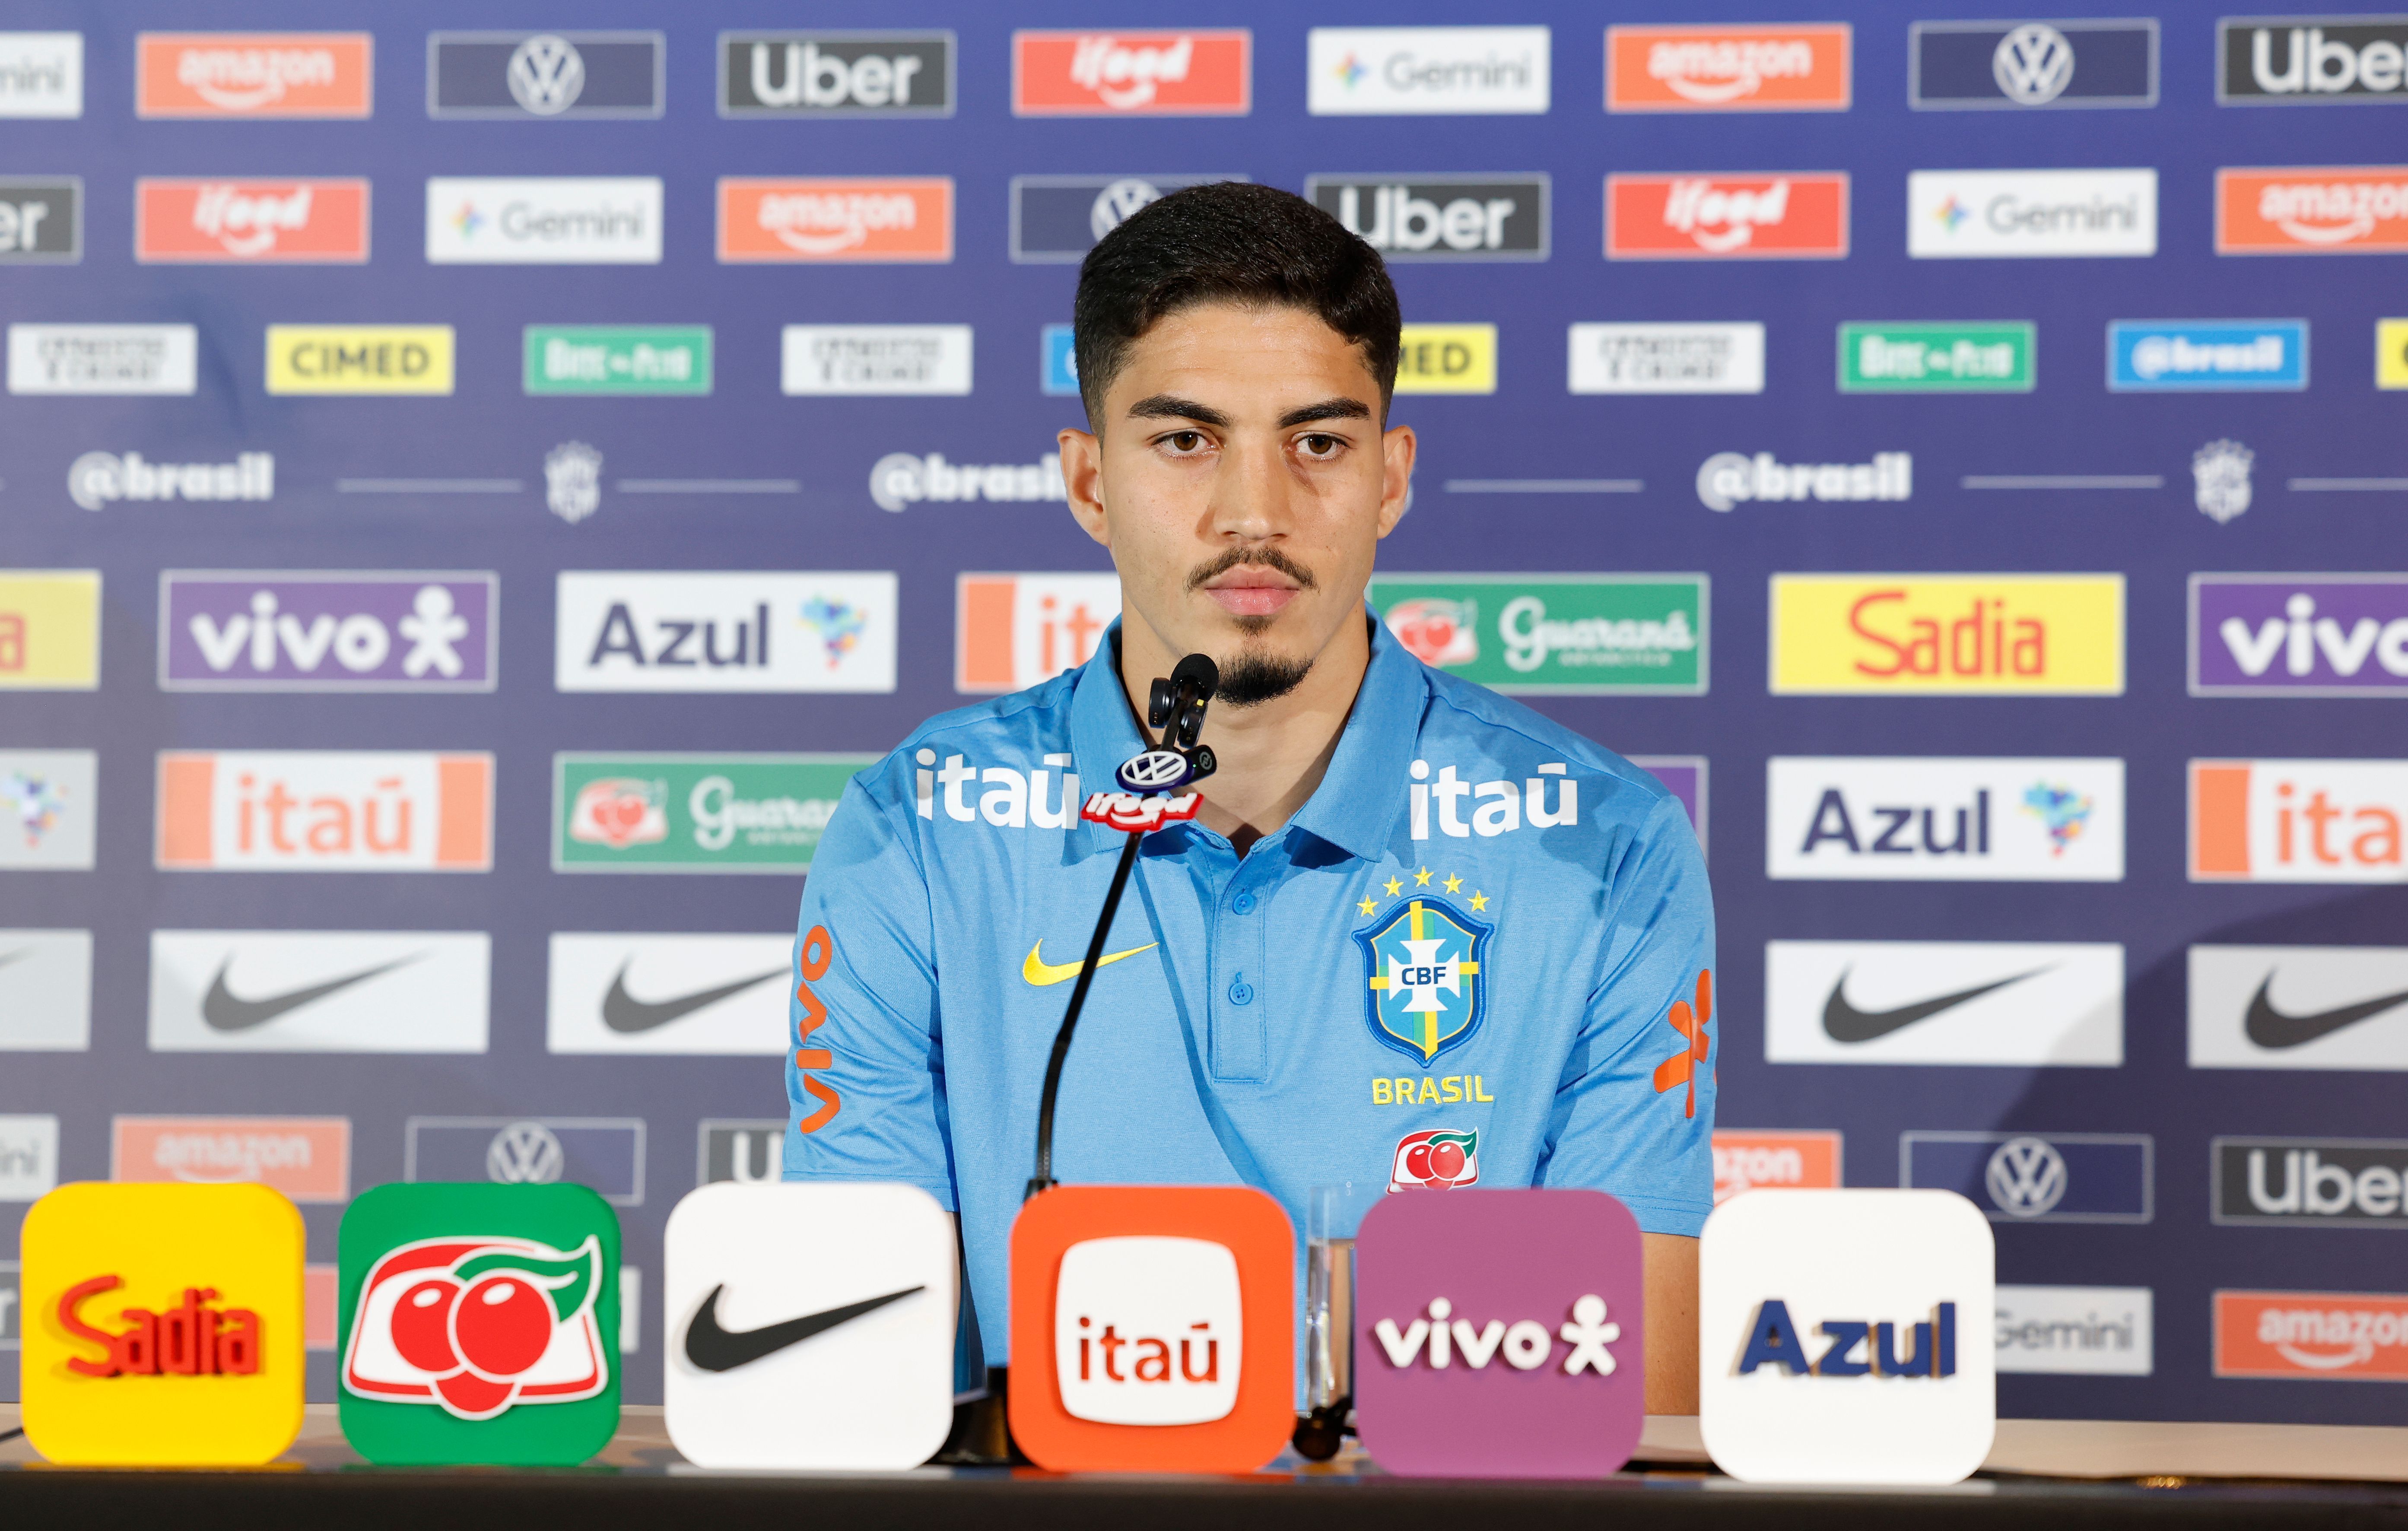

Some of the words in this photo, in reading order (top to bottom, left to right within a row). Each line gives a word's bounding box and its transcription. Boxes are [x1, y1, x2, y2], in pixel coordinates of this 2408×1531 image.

[178, 50, 334, 86] amazon
[751, 42, 923, 106] Uber
[1384, 51, 1531, 91] Gemini
[1648, 41, 1813, 78] amazon
[2250, 28, 2408, 93] Ube
[500, 201, 645, 241] Gemini
[758, 194, 916, 231] amazon
[1341, 186, 1515, 250] Uber
[1985, 194, 2138, 234] Gemini
[290, 343, 431, 378] CIMED
[68, 451, 275, 511] @brasil
[1696, 451, 1912, 513] @brasil
[190, 590, 391, 673] vivo
[588, 601, 770, 669] Azul
[1847, 588, 2046, 679] Sadia
[237, 772, 413, 855] itaú
[1801, 787, 1990, 857] Azul
[2277, 781, 2403, 865] ita
[1401, 966, 1447, 987] CBF
[1372, 1074, 1494, 1105] BRASIL
[154, 1134, 312, 1167] amazon
[2249, 1150, 2408, 1216] Ube
[57, 1275, 259, 1378] Sadia
[1078, 1316, 1219, 1383] itaú
[1375, 1296, 1552, 1370] vivo
[1730, 1299, 1956, 1379] Azul
